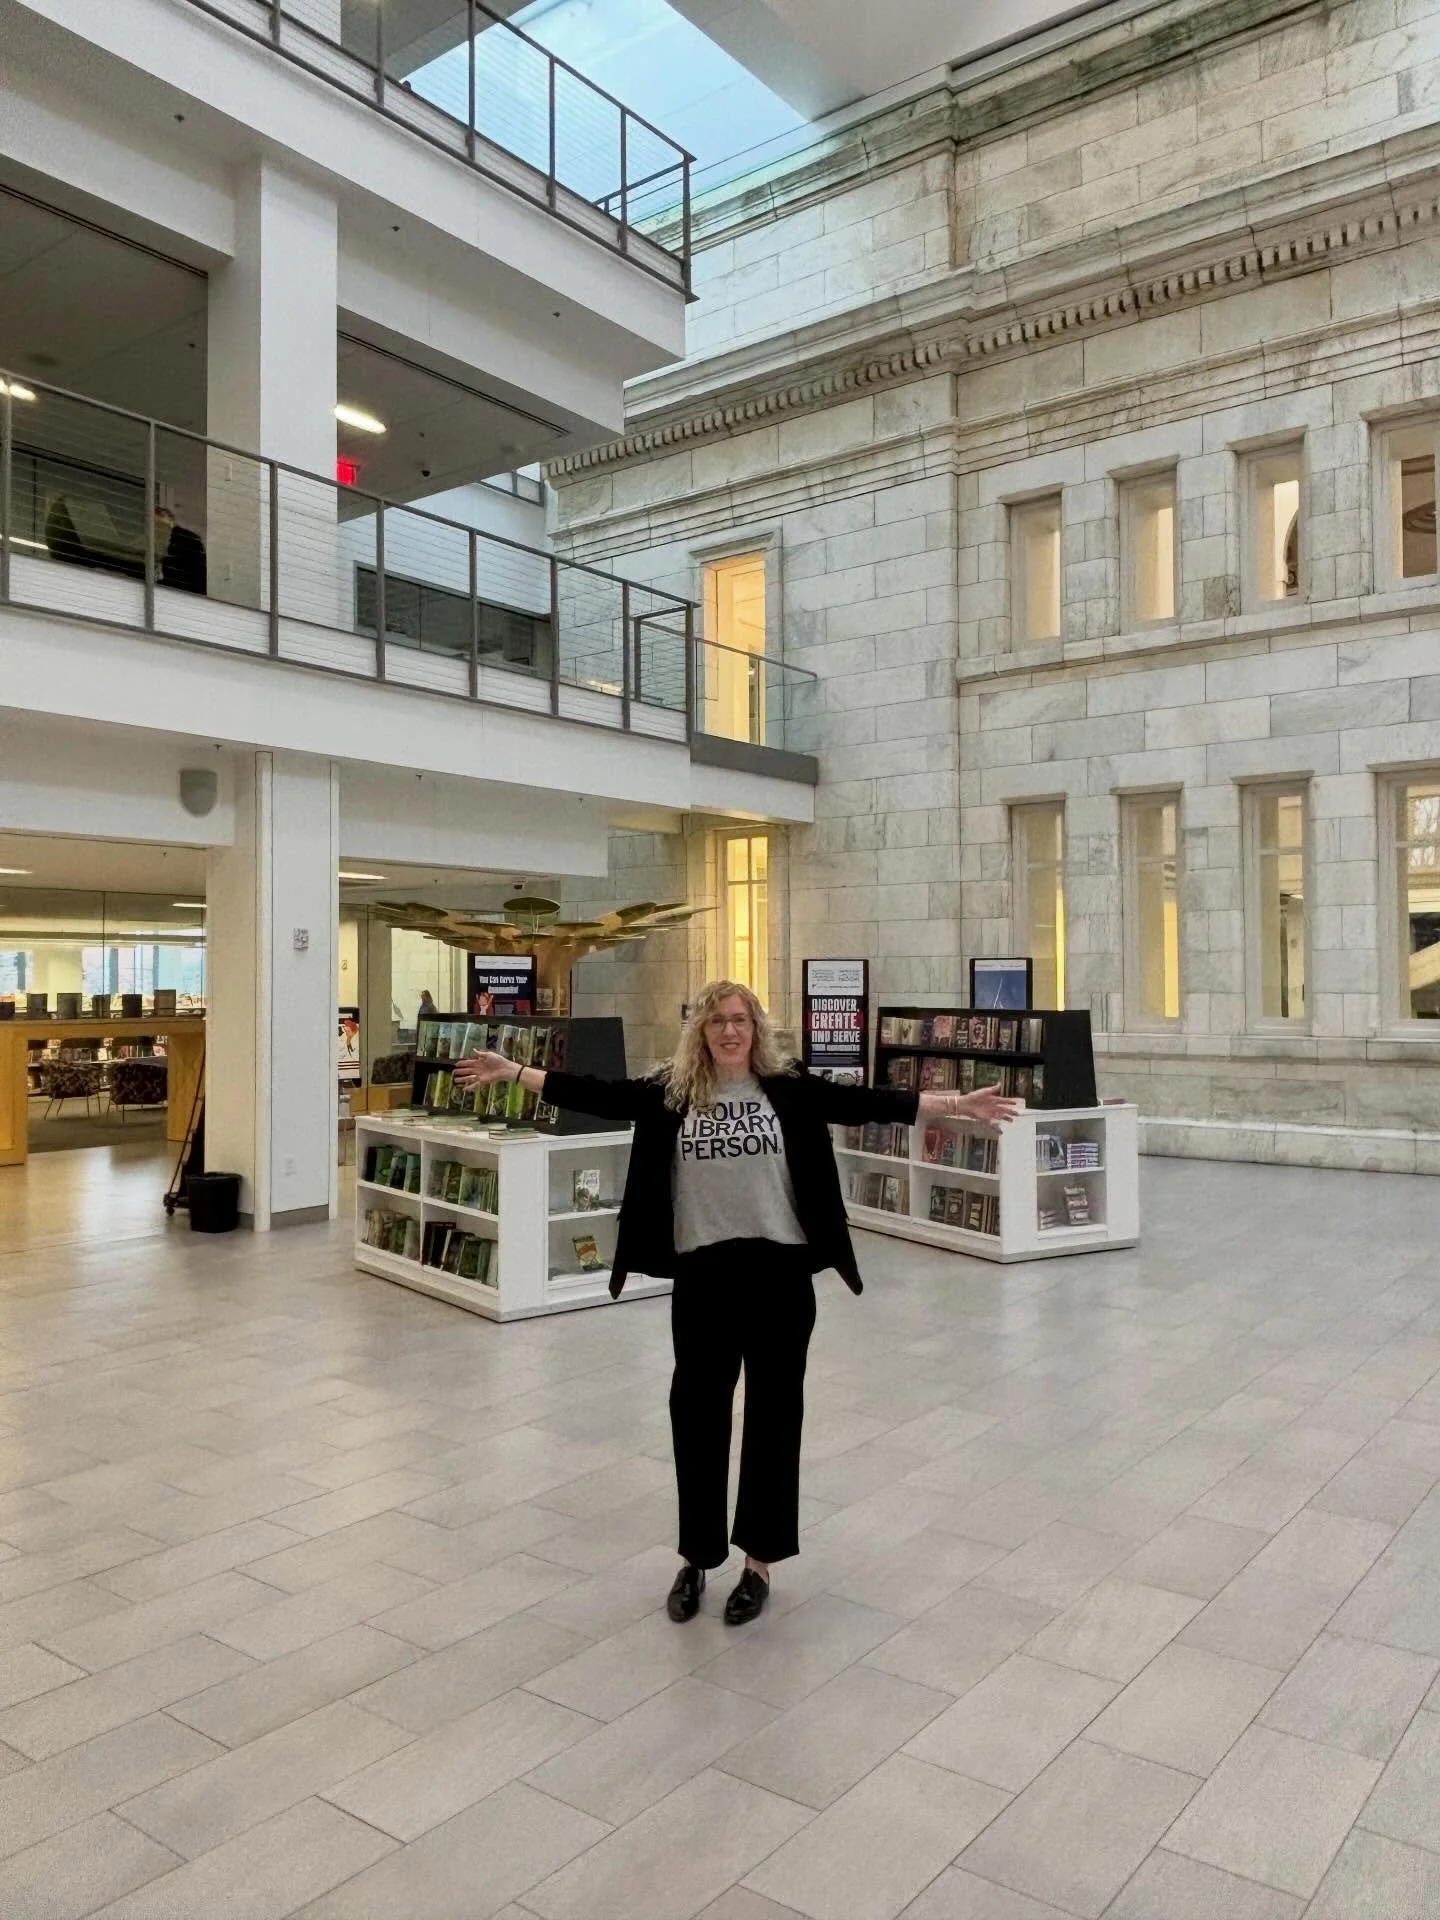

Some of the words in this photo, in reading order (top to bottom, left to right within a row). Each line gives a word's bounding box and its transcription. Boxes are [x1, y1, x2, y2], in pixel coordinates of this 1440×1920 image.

[811, 1012, 861, 1030] CREATE.
[811, 1030, 831, 1043] AND
[832, 1030, 860, 1043] SERVE
[696, 1101, 761, 1122] ROUD
[681, 1114, 776, 1139] LIBRARY
